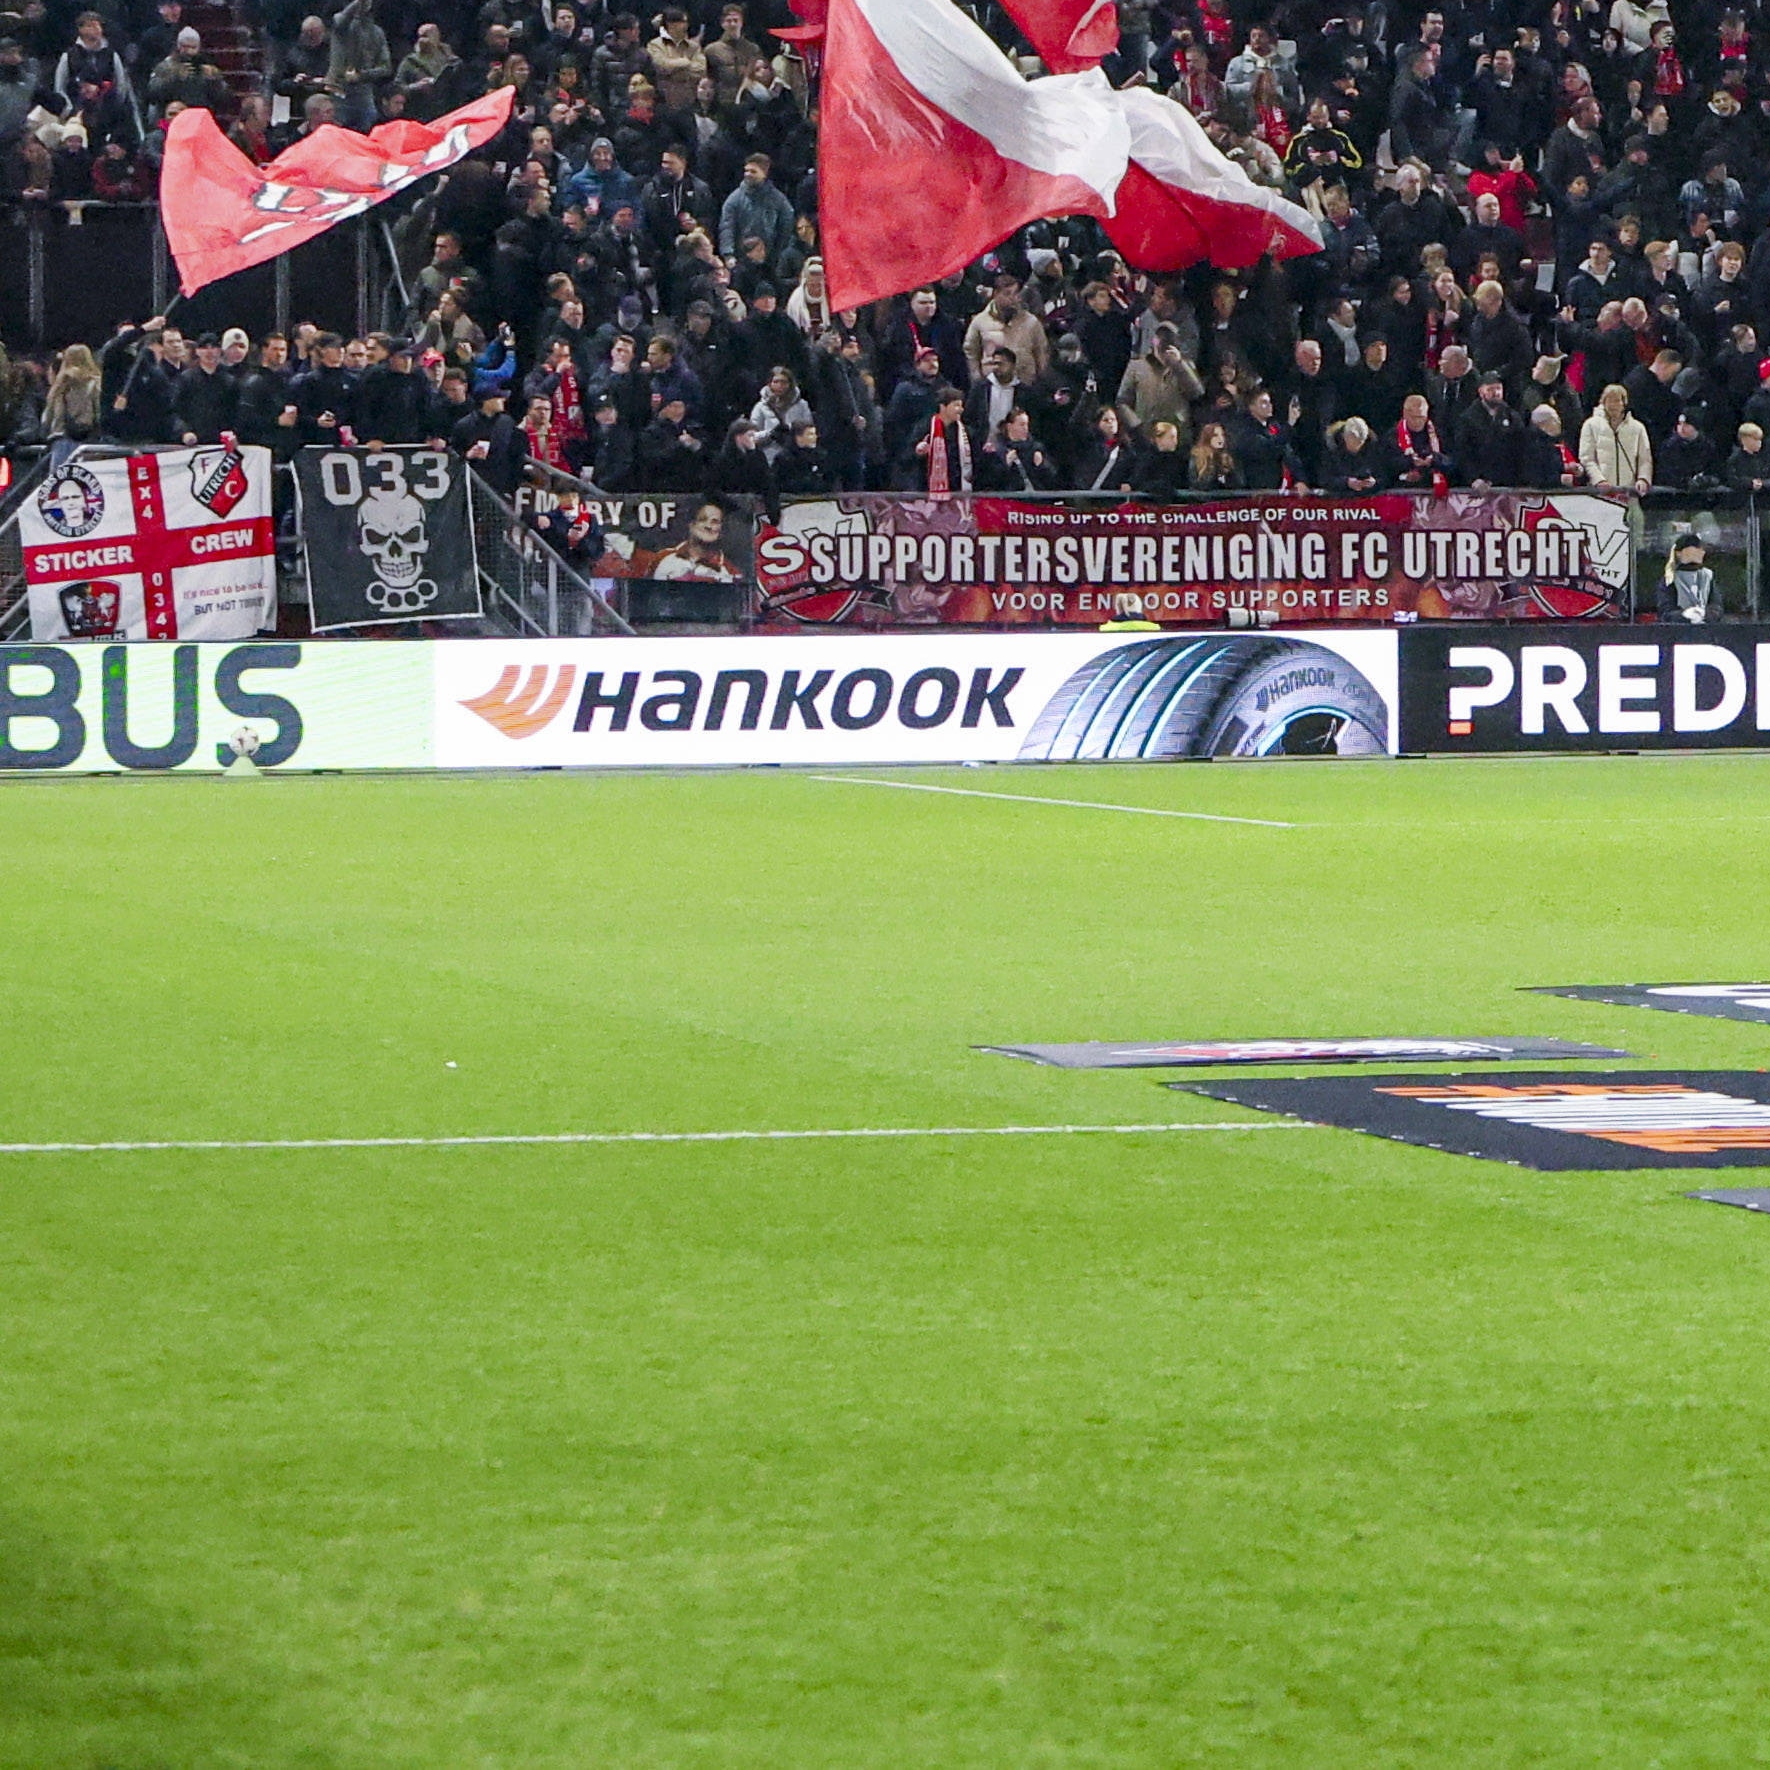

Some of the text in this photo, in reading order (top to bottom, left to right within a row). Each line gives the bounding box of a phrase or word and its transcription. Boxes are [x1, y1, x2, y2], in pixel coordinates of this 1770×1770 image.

[320, 451, 450, 506] 033
[637, 501, 677, 530] OF
[1008, 511, 1065, 526] RISING
[1099, 512, 1120, 525] TO
[1126, 511, 1157, 525] THE
[1162, 508, 1260, 526] CHALLENGE
[1265, 508, 1287, 522] OF
[1292, 507, 1329, 522] OUR
[1333, 507, 1381, 521] RIVAL
[34, 529, 254, 573] STICKER CREW
[809, 530, 1590, 584] SUPPORTERSVERENIGING FC UTRECHT
[992, 589, 1390, 612] VOOR EN OOR SUPPORTERS
